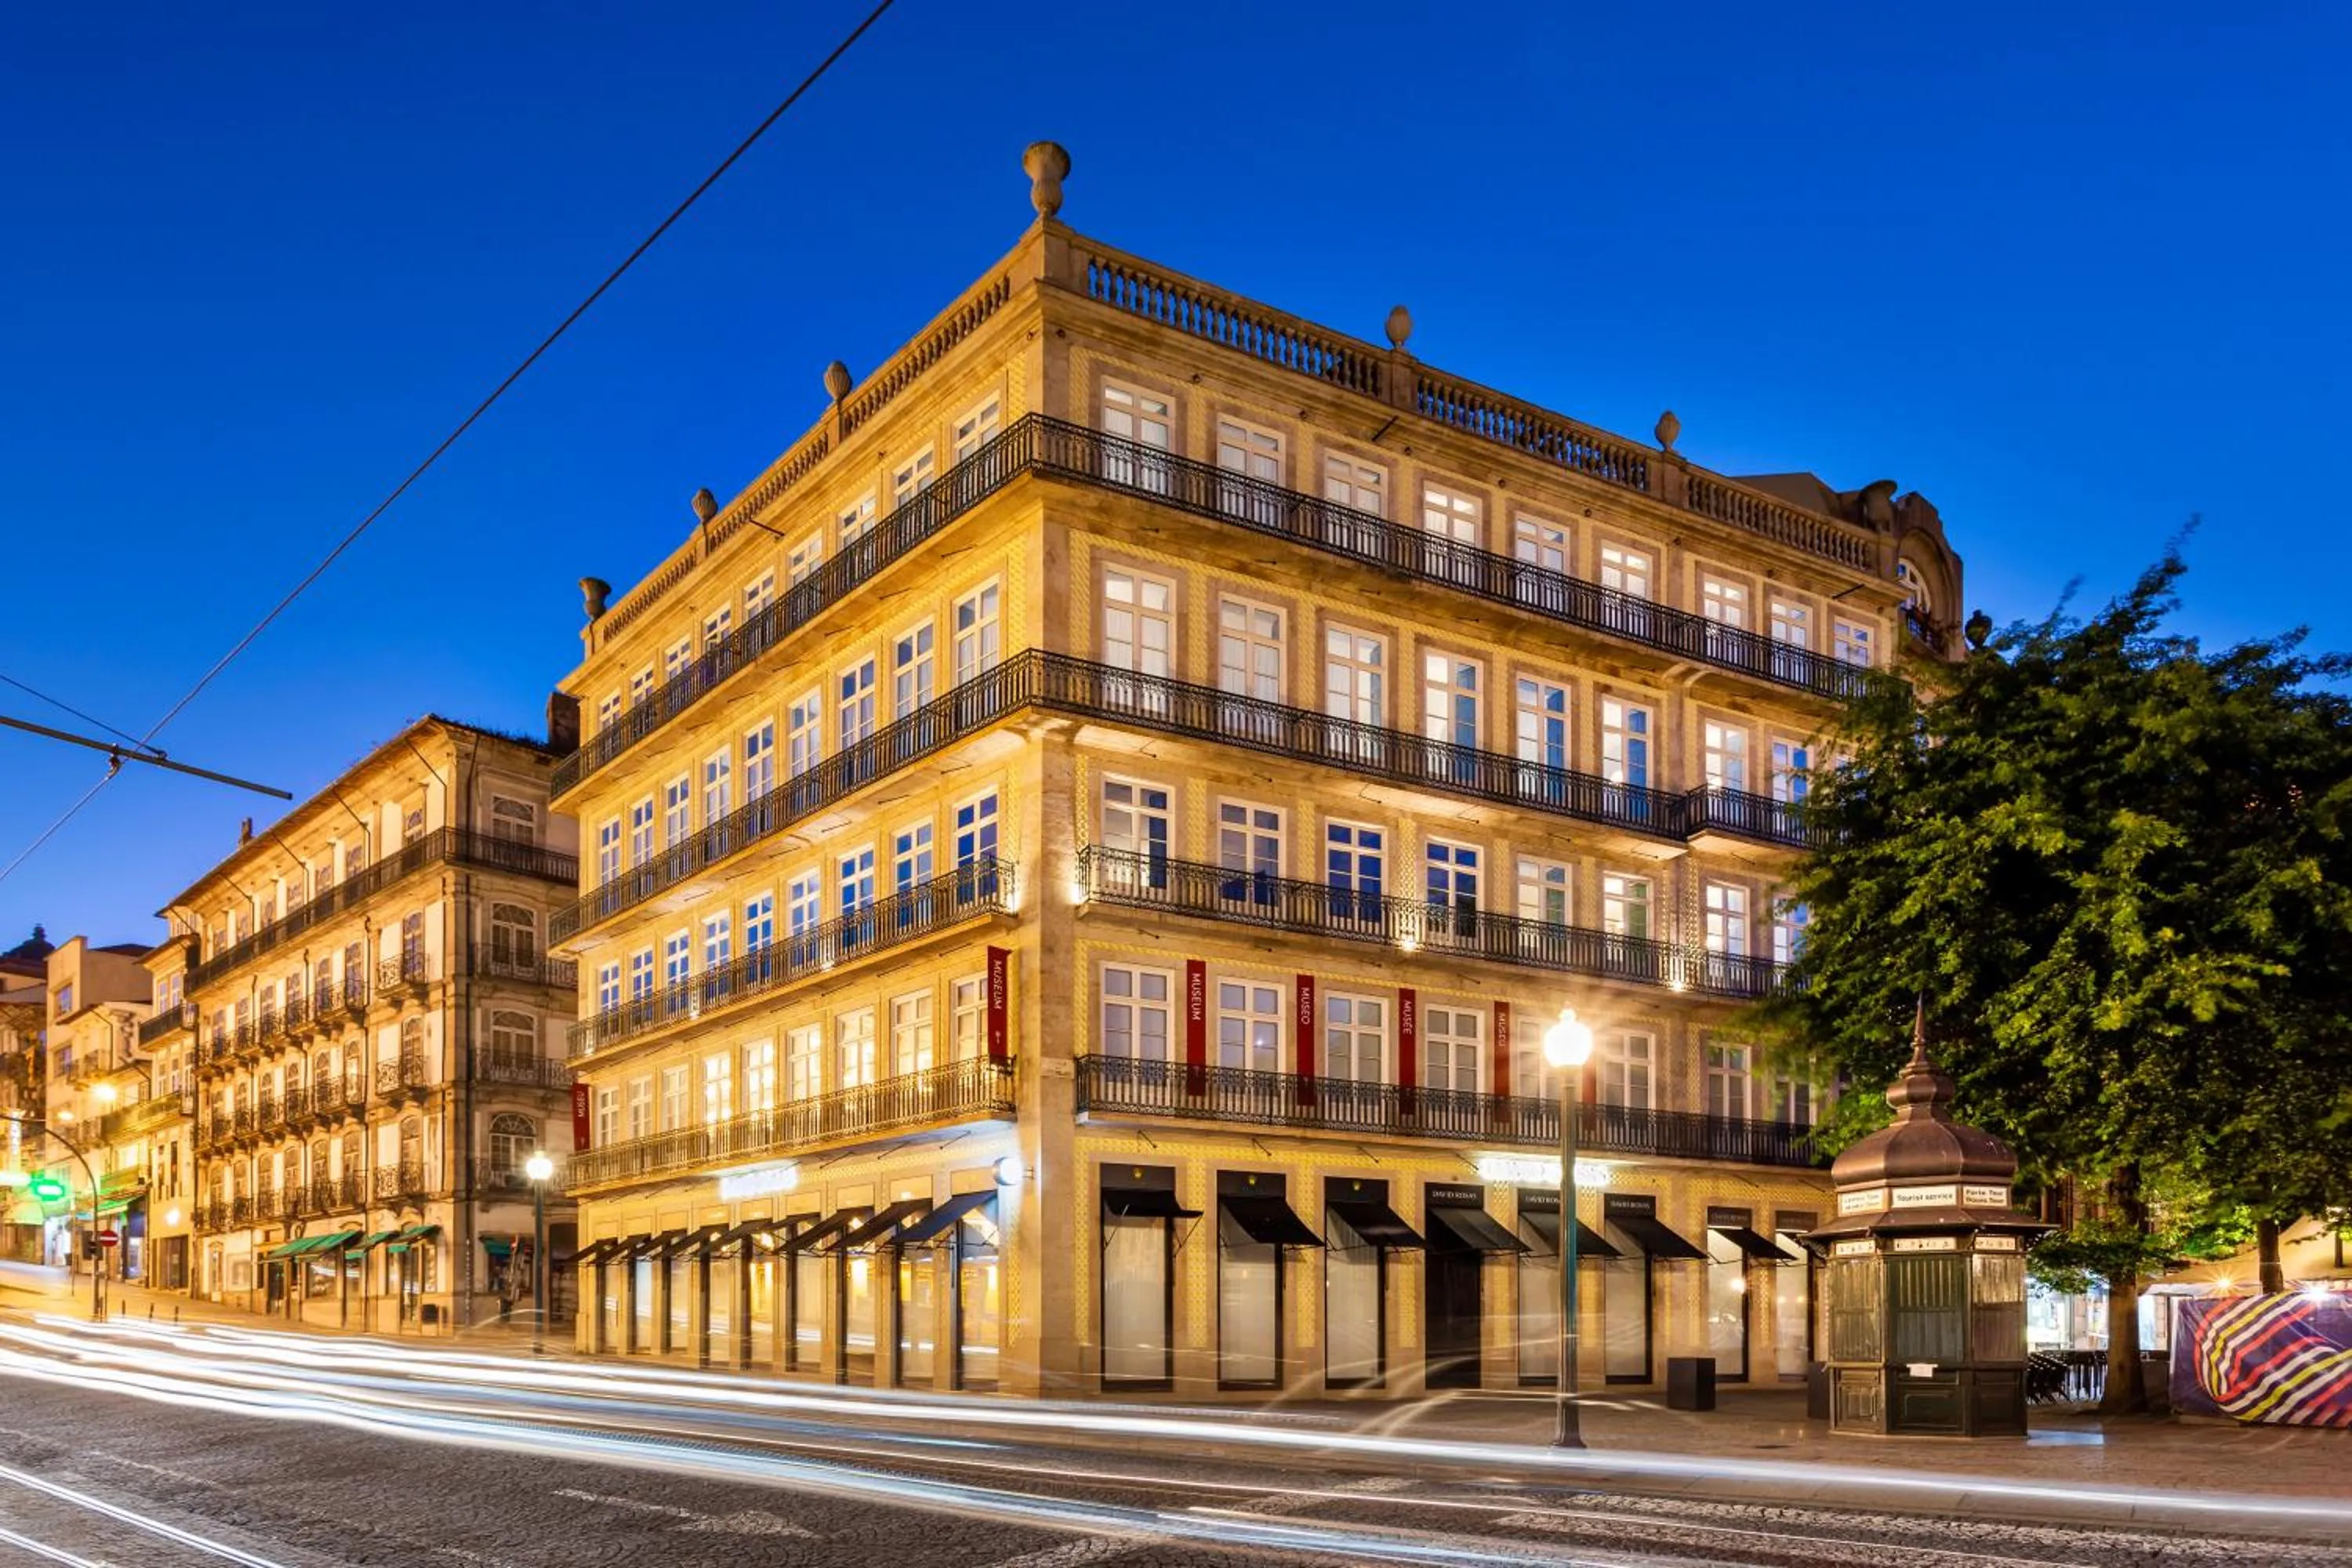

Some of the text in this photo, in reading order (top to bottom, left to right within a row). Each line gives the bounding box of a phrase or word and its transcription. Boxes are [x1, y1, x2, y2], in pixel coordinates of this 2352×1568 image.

[993, 959, 1003, 1010] MUSEUM
[1191, 973, 1202, 1021] MUSEUM
[1301, 987, 1311, 1025] MUSEO
[1403, 1000, 1414, 1035] MUSÉE
[1896, 1193, 1923, 1202] Tourist
